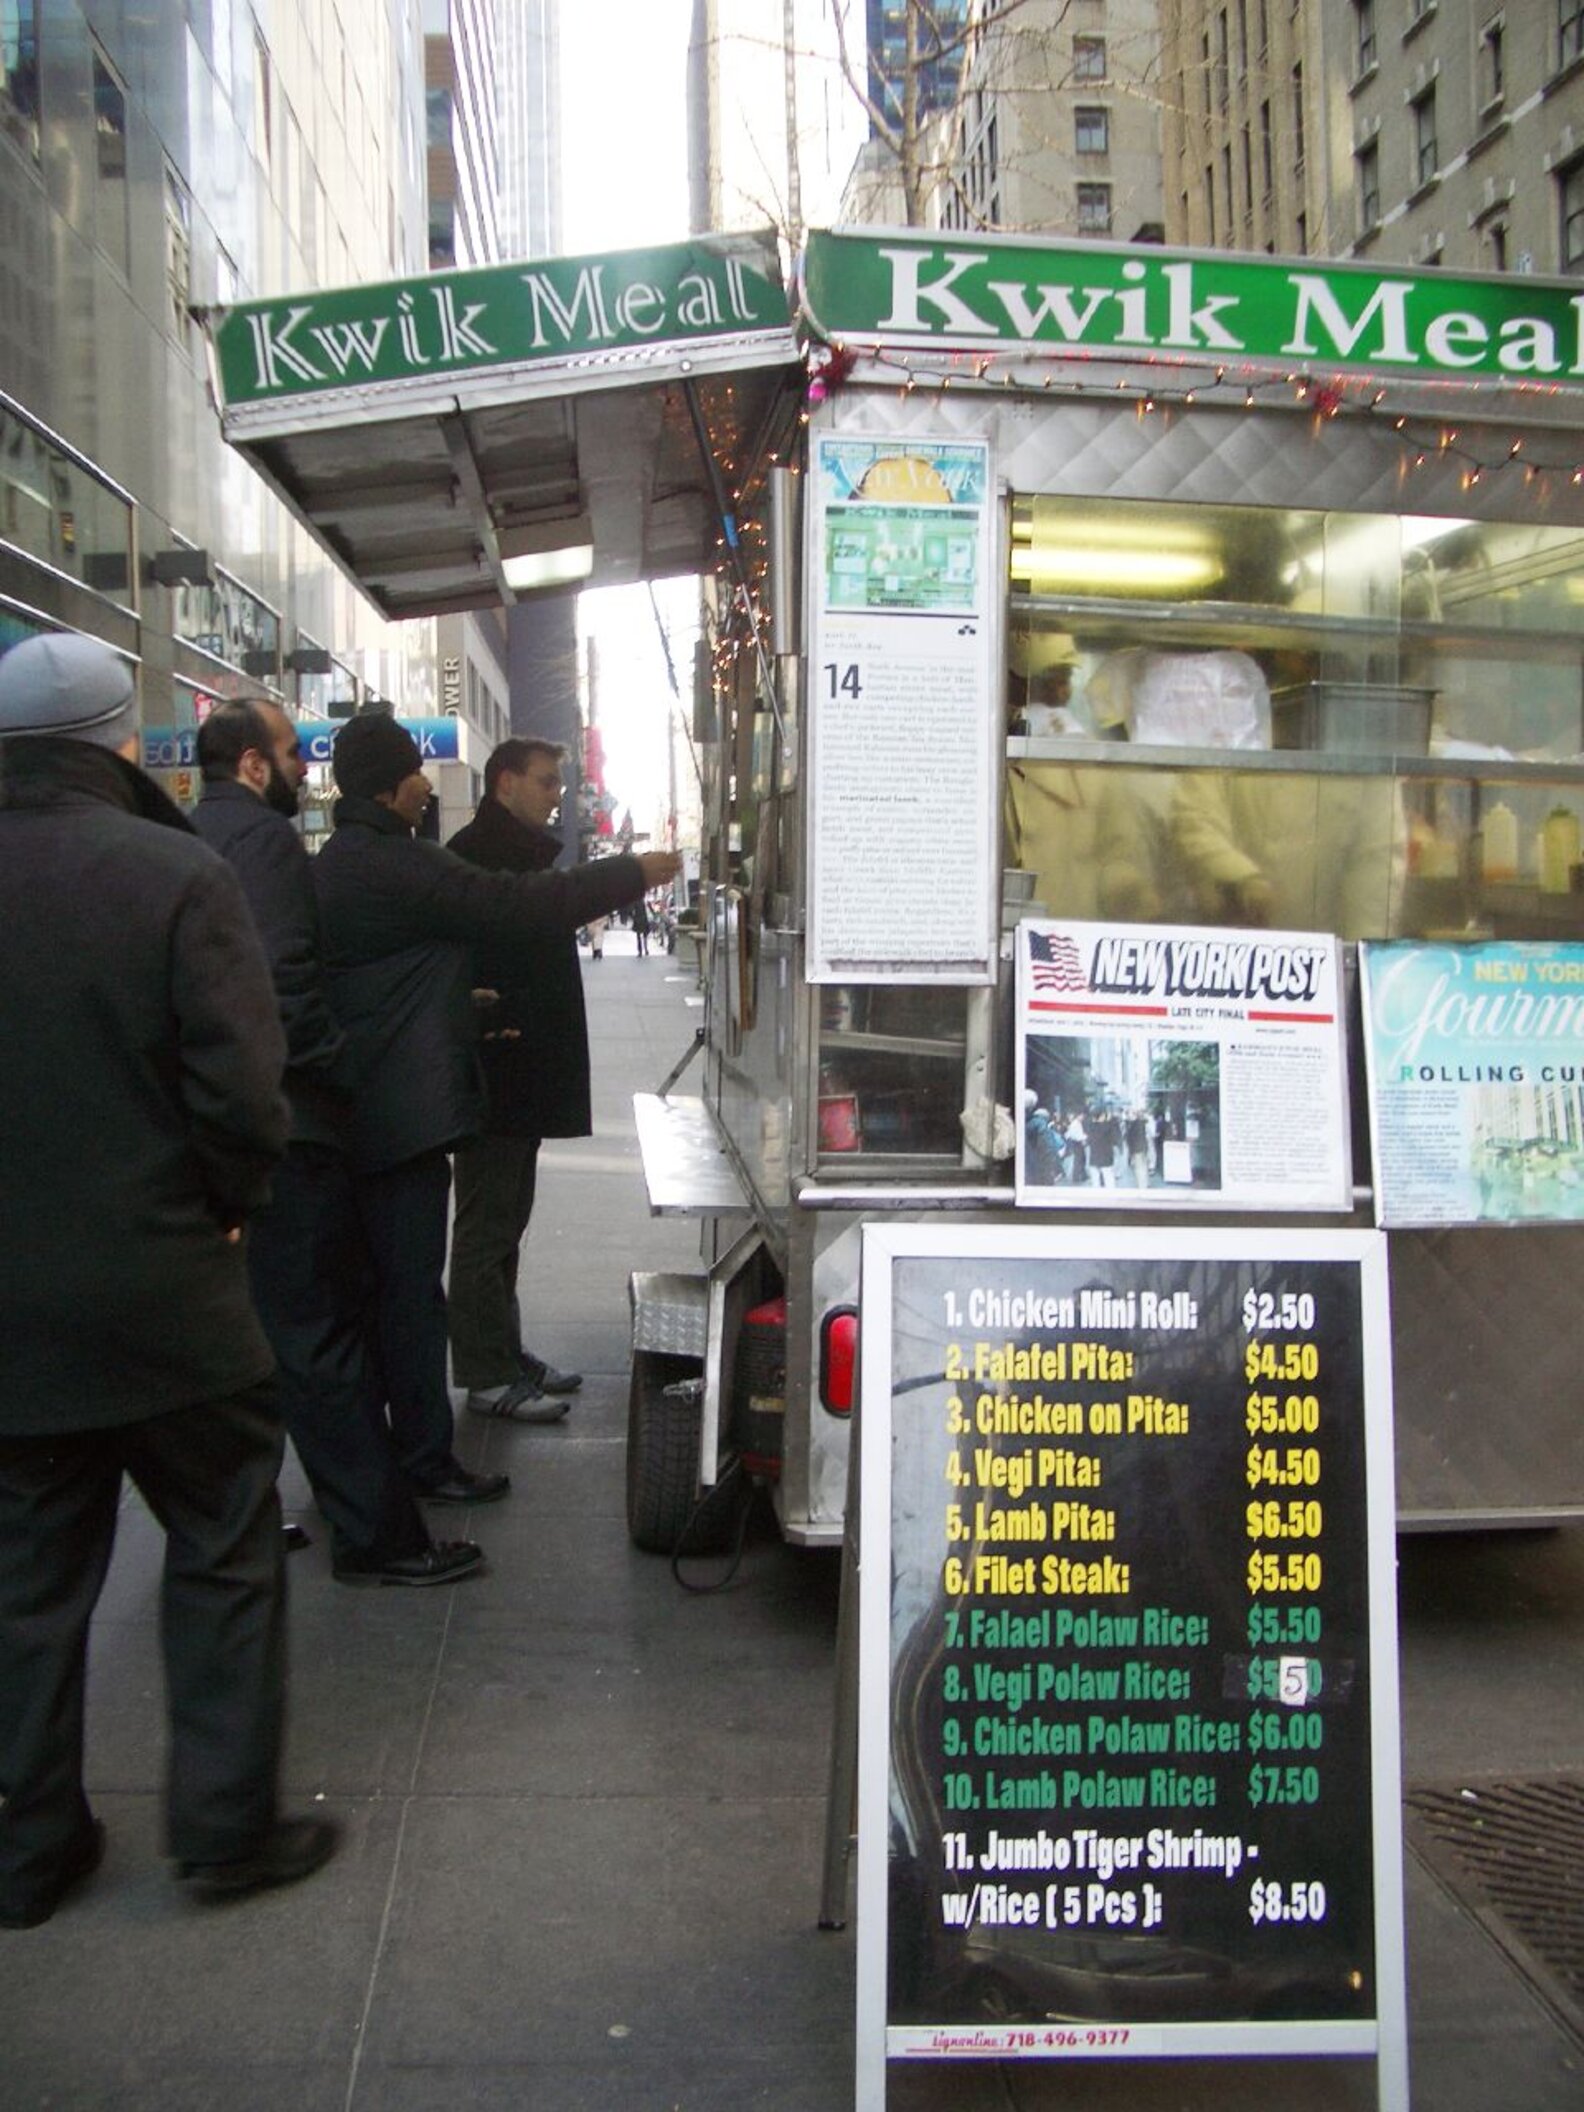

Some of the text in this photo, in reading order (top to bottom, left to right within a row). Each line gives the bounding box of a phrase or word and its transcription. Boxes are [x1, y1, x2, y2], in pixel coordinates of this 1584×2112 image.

[877, 249, 1246, 350] Kwik
[246, 258, 759, 389] Kwik Meal
[444, 656, 461, 718] OWER
[824, 663, 863, 699] 14
[1089, 937, 1328, 1001] NEW YORK POST
[1475, 961, 1528, 983] NEW
[1171, 1006, 1245, 1020] LATE CITY FINAL
[1401, 1065, 1524, 1083] ROLLING
[944, 1288, 1314, 1333] 1. Chicken Mini Roll: $2.50
[945, 1344, 968, 1380] 2.
[1072, 1345, 1134, 1381] Pita:
[1245, 1341, 1318, 1384] $4.50
[946, 1394, 1318, 1437] 3. Chicken on Pita: $5.00
[945, 1446, 1320, 1498] 4. Vegi Pita: $4.50
[946, 1500, 1321, 1542] 5. Lamb Pita: $6.50
[945, 1552, 1321, 1595] 6. Filet Steak: $5.50
[945, 1604, 1321, 1648] 7. Falael Polaw Rice: $5.50
[944, 1665, 967, 1702] 8.
[974, 1663, 1032, 1711] Vegi
[1038, 1663, 1119, 1702] Polaw
[1125, 1662, 1190, 1700] Rice:
[944, 1709, 1322, 1756] 9. Chicken Polaw Rice: $6.00
[944, 1763, 1318, 1809] 10. Lamb Polaw Rice: $7.50
[943, 1833, 973, 1869] 11.
[980, 1830, 1069, 1869] Jumbo
[1073, 1830, 1142, 1880] Tiger
[1147, 1829, 1241, 1877] Shrimp
[943, 1884, 1040, 1929] w/Rice
[1064, 1886, 1080, 1924] 5
[1087, 1884, 1136, 1924] Pcs
[1250, 1879, 1325, 1926] $8.50
[1006, 2030, 1130, 2047] 718-496-9377
